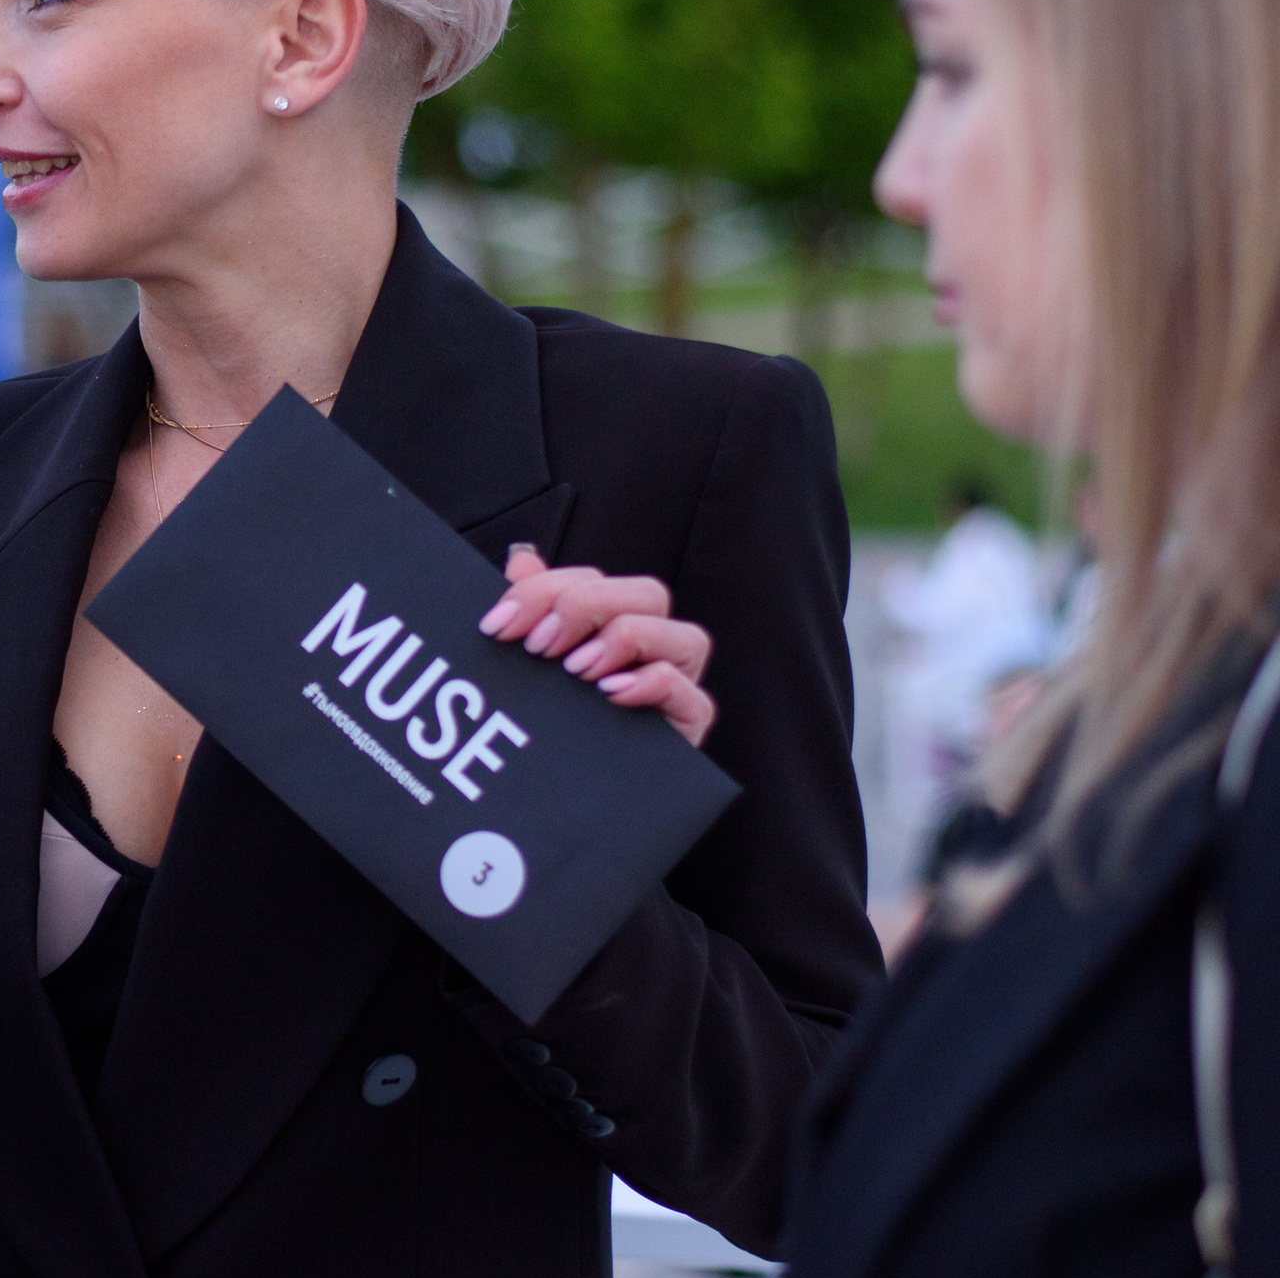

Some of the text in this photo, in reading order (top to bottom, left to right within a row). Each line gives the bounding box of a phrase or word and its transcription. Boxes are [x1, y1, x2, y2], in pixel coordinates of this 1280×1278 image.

[300, 582, 530, 802] MUSE
[301, 681, 435, 806] #тымоевдохновение
[472, 861, 494, 886] 3
